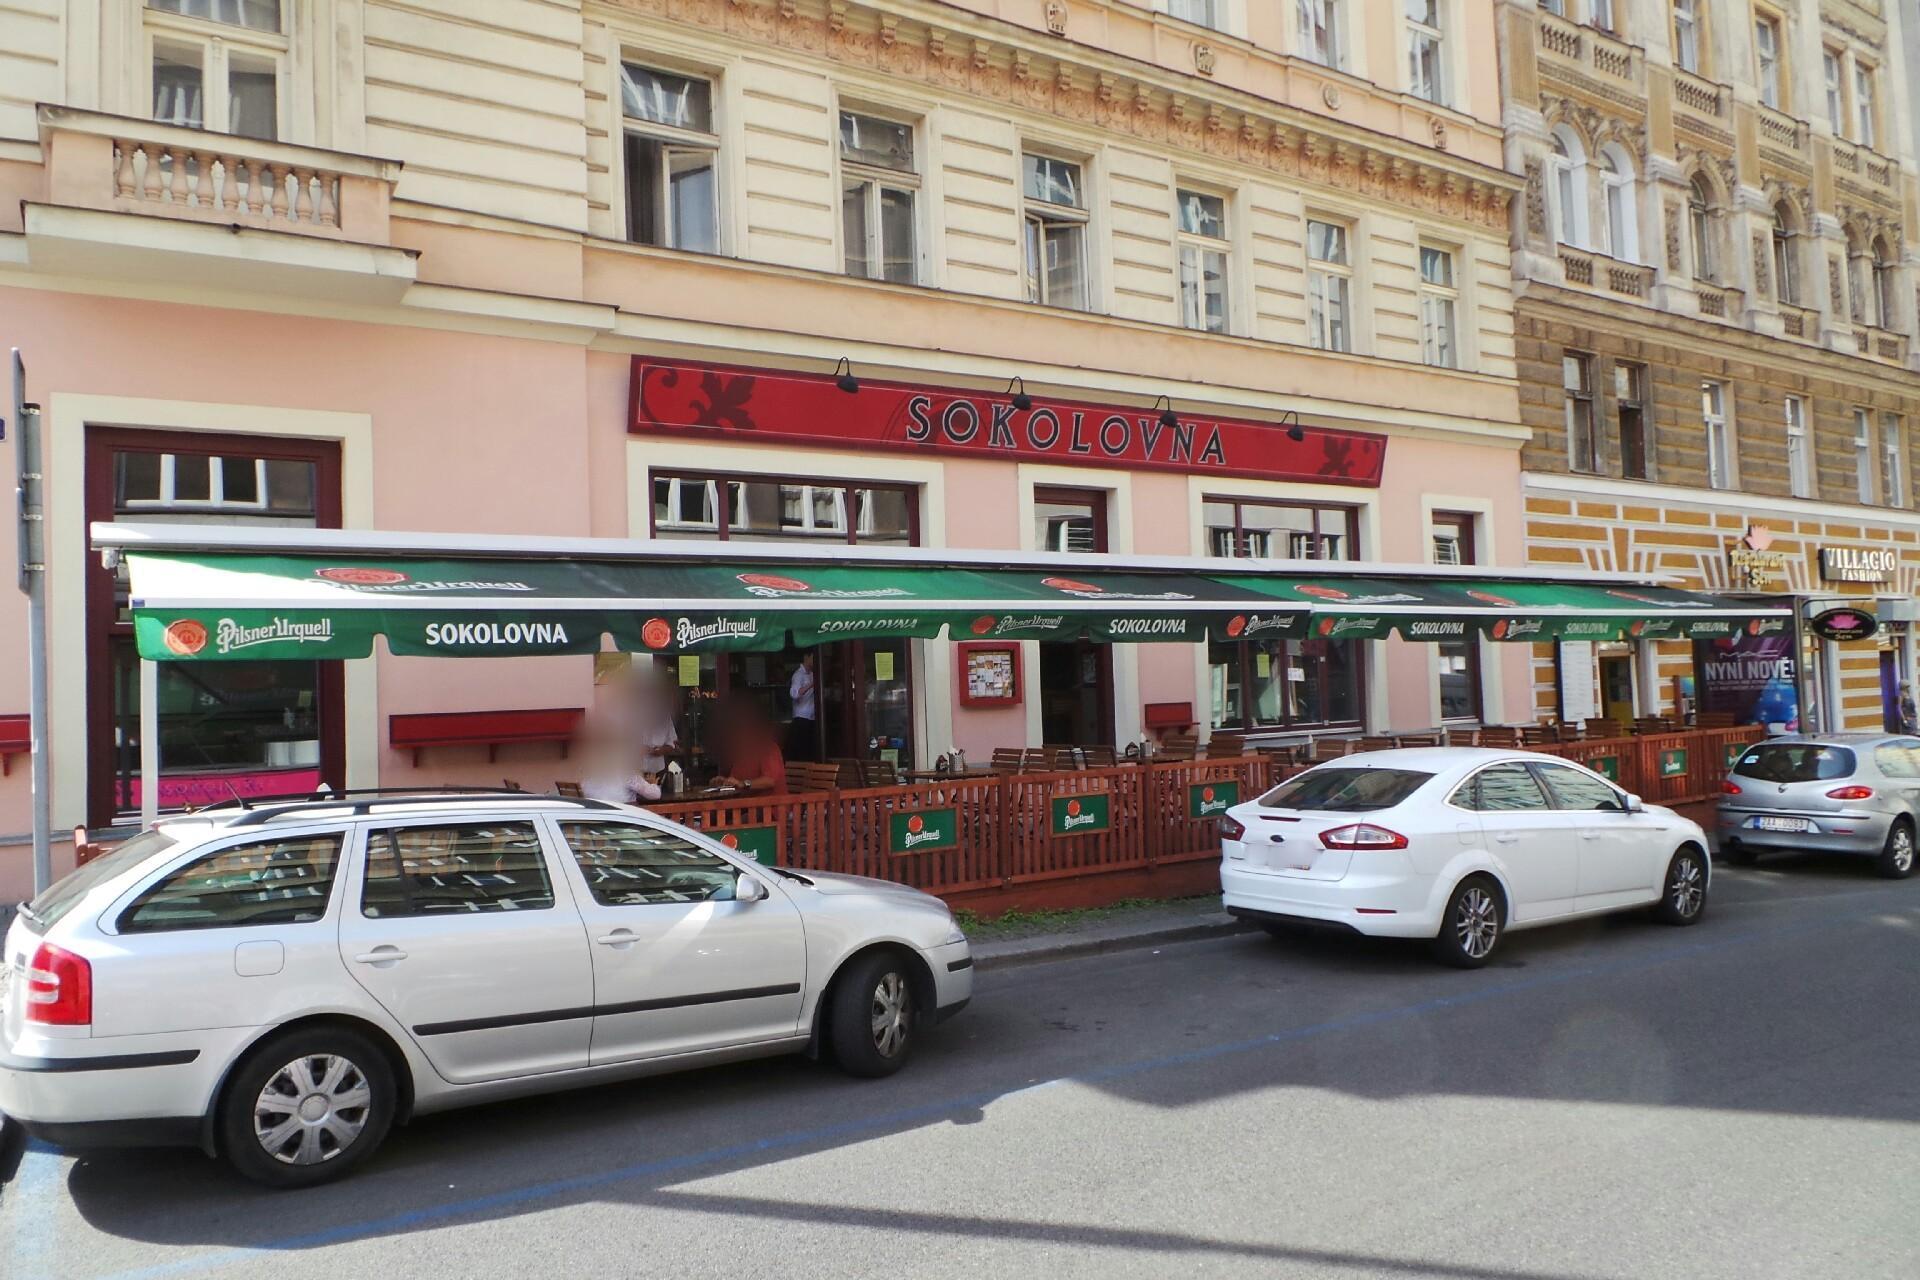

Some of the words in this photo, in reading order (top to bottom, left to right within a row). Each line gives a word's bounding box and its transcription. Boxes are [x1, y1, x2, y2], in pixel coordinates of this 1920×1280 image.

[906, 396, 1227, 464] SOKOLOVNA
[1825, 548, 1895, 571] VILLAGIO
[1841, 569, 1882, 581] FASHION
[216, 617, 276, 654] Pilsner
[273, 616, 333, 643] Urquell
[425, 623, 568, 645] SOKOLOVNA
[676, 617, 719, 649] Pilsner
[717, 616, 758, 639] Urquell
[817, 619, 917, 634] SOKOLOVNA
[1109, 619, 1187, 634] SOKOLOVNA
[1411, 621, 1464, 635] SOKOLOVNA
[1704, 659, 1745, 681] NYNÍ
[1747, 656, 1796, 680] NOVĚ!
